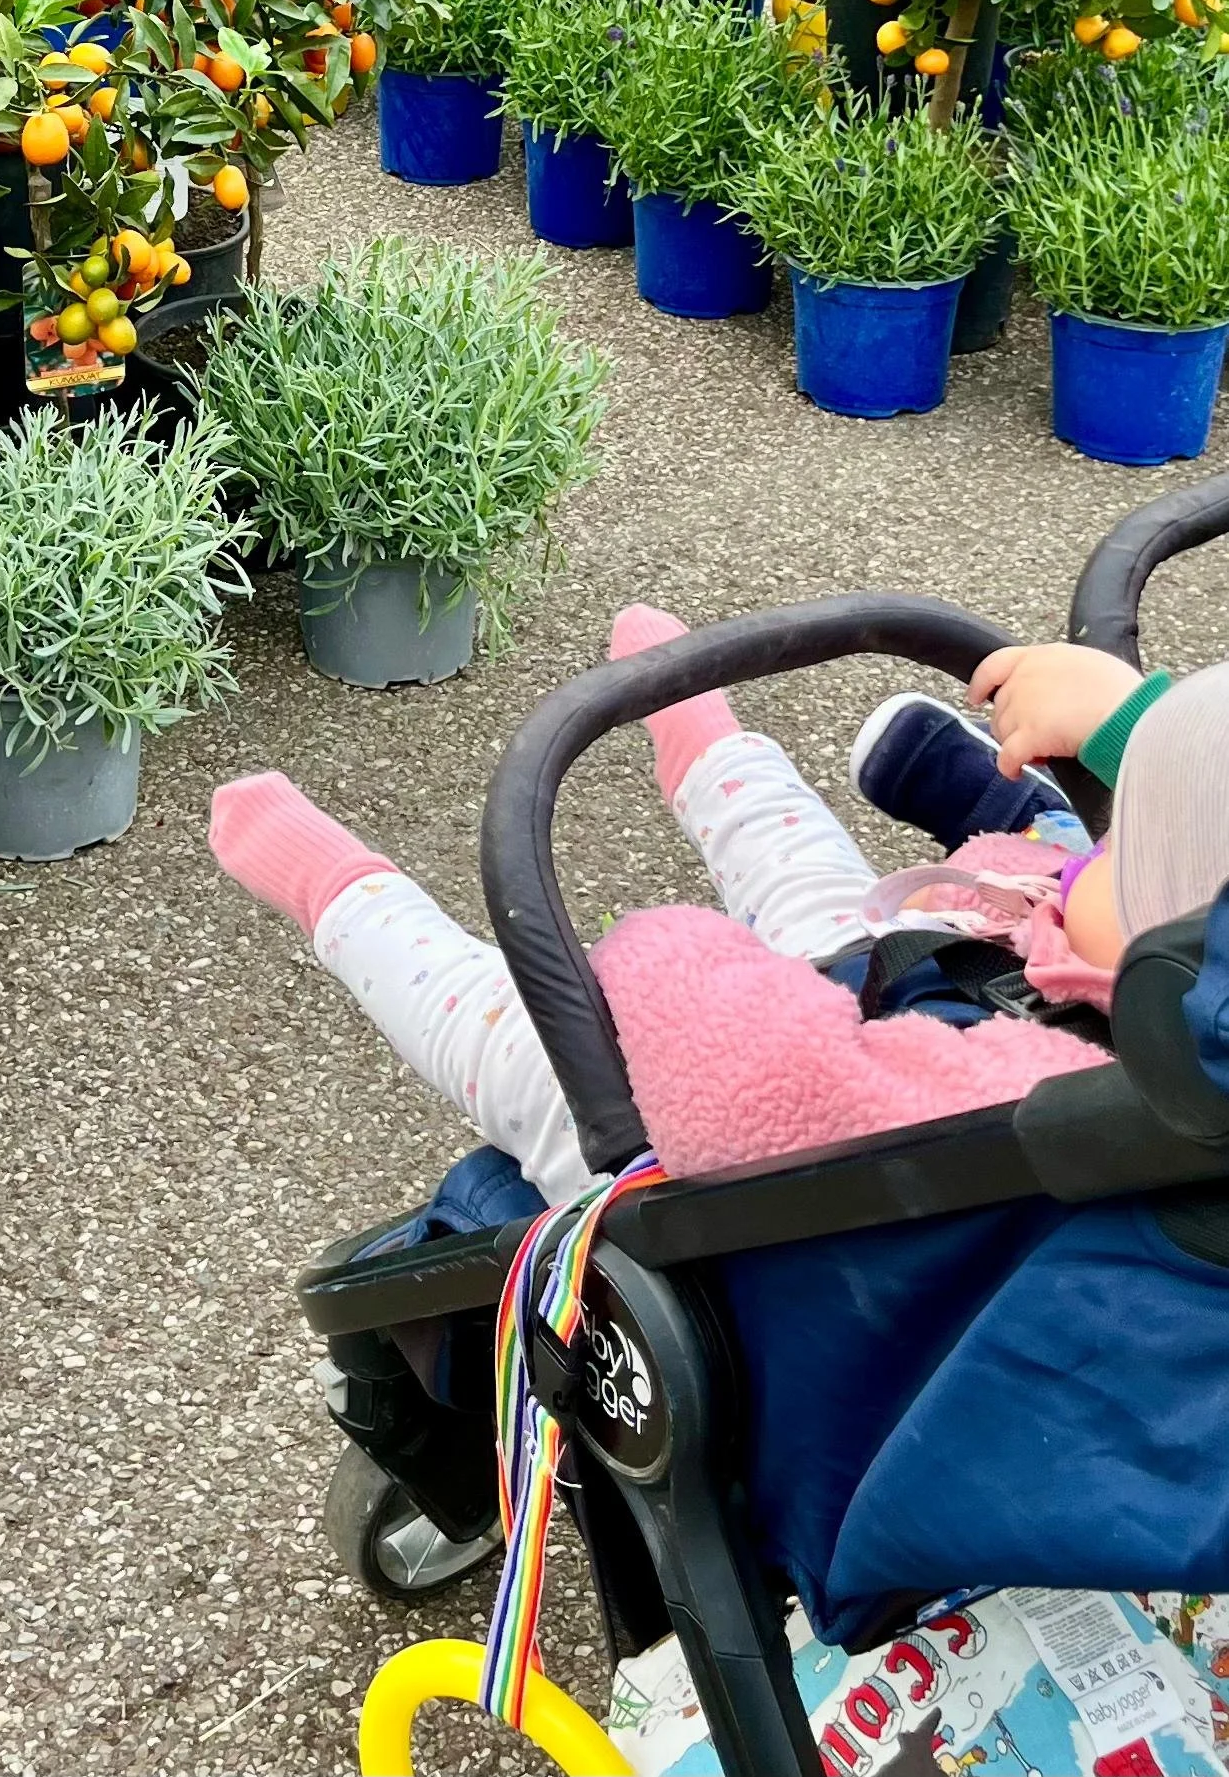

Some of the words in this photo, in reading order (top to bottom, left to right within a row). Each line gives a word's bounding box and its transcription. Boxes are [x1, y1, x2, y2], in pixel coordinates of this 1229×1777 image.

[586, 1360, 648, 1435] gger
[1084, 1701, 1118, 1725] baby
[1116, 1682, 1152, 1717] jogger
